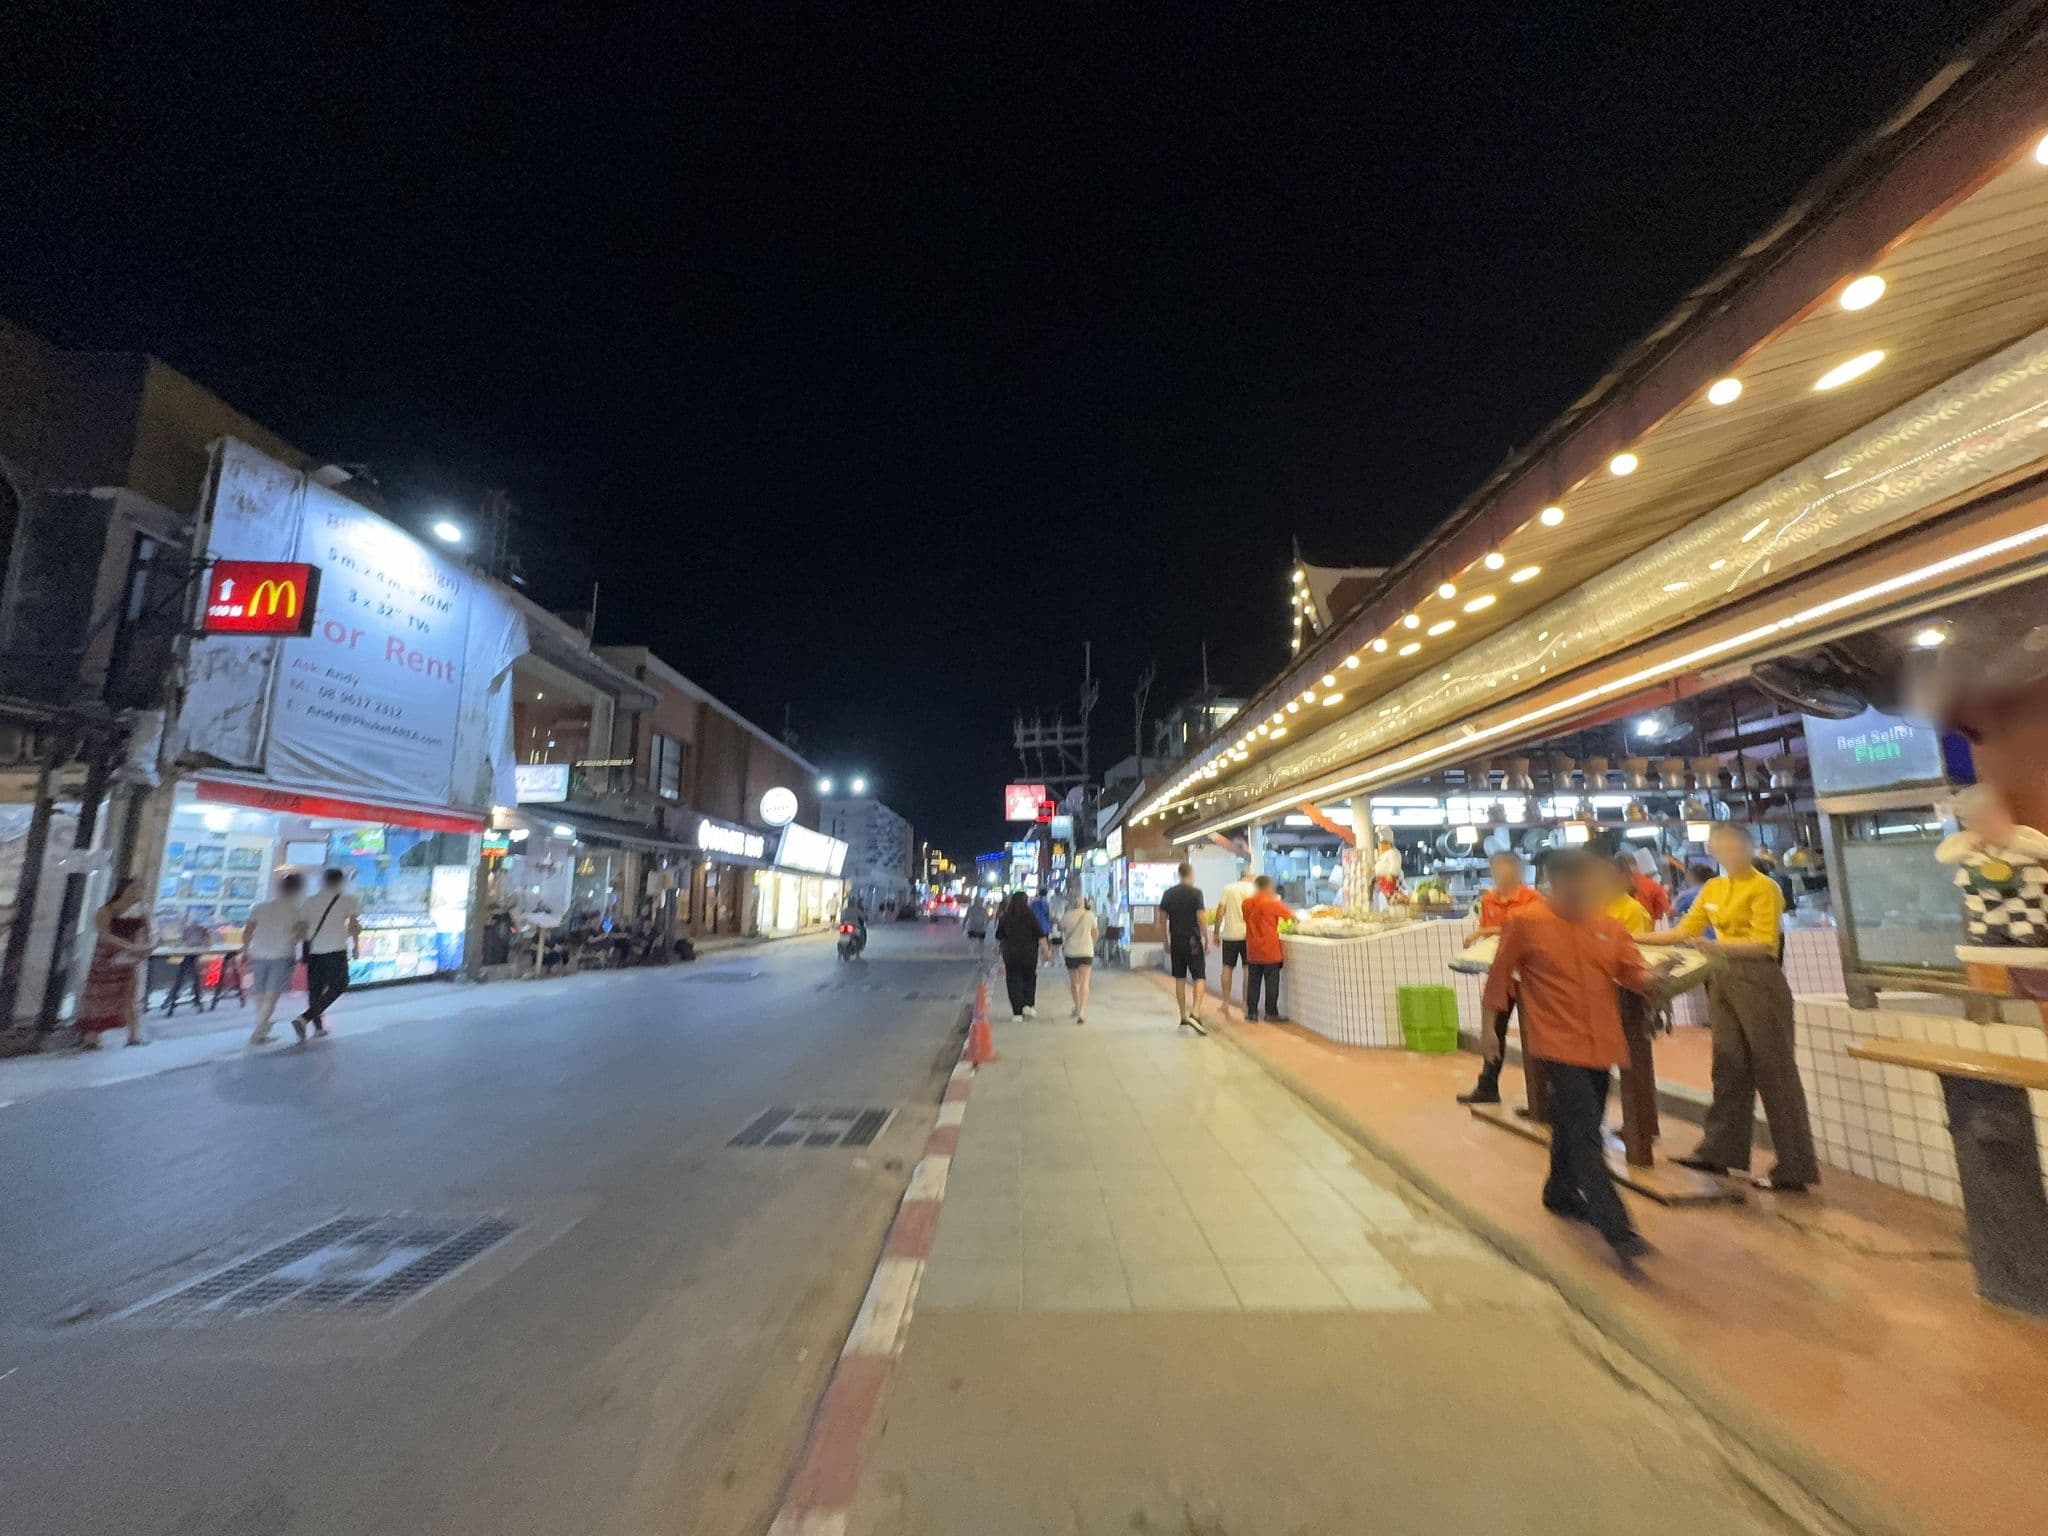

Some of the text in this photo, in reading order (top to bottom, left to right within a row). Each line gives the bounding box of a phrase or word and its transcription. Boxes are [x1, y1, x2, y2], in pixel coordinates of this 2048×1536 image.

[384, 635, 457, 684] Rent
[324, 667, 361, 688] Andy
[1836, 733, 1867, 750] Best
